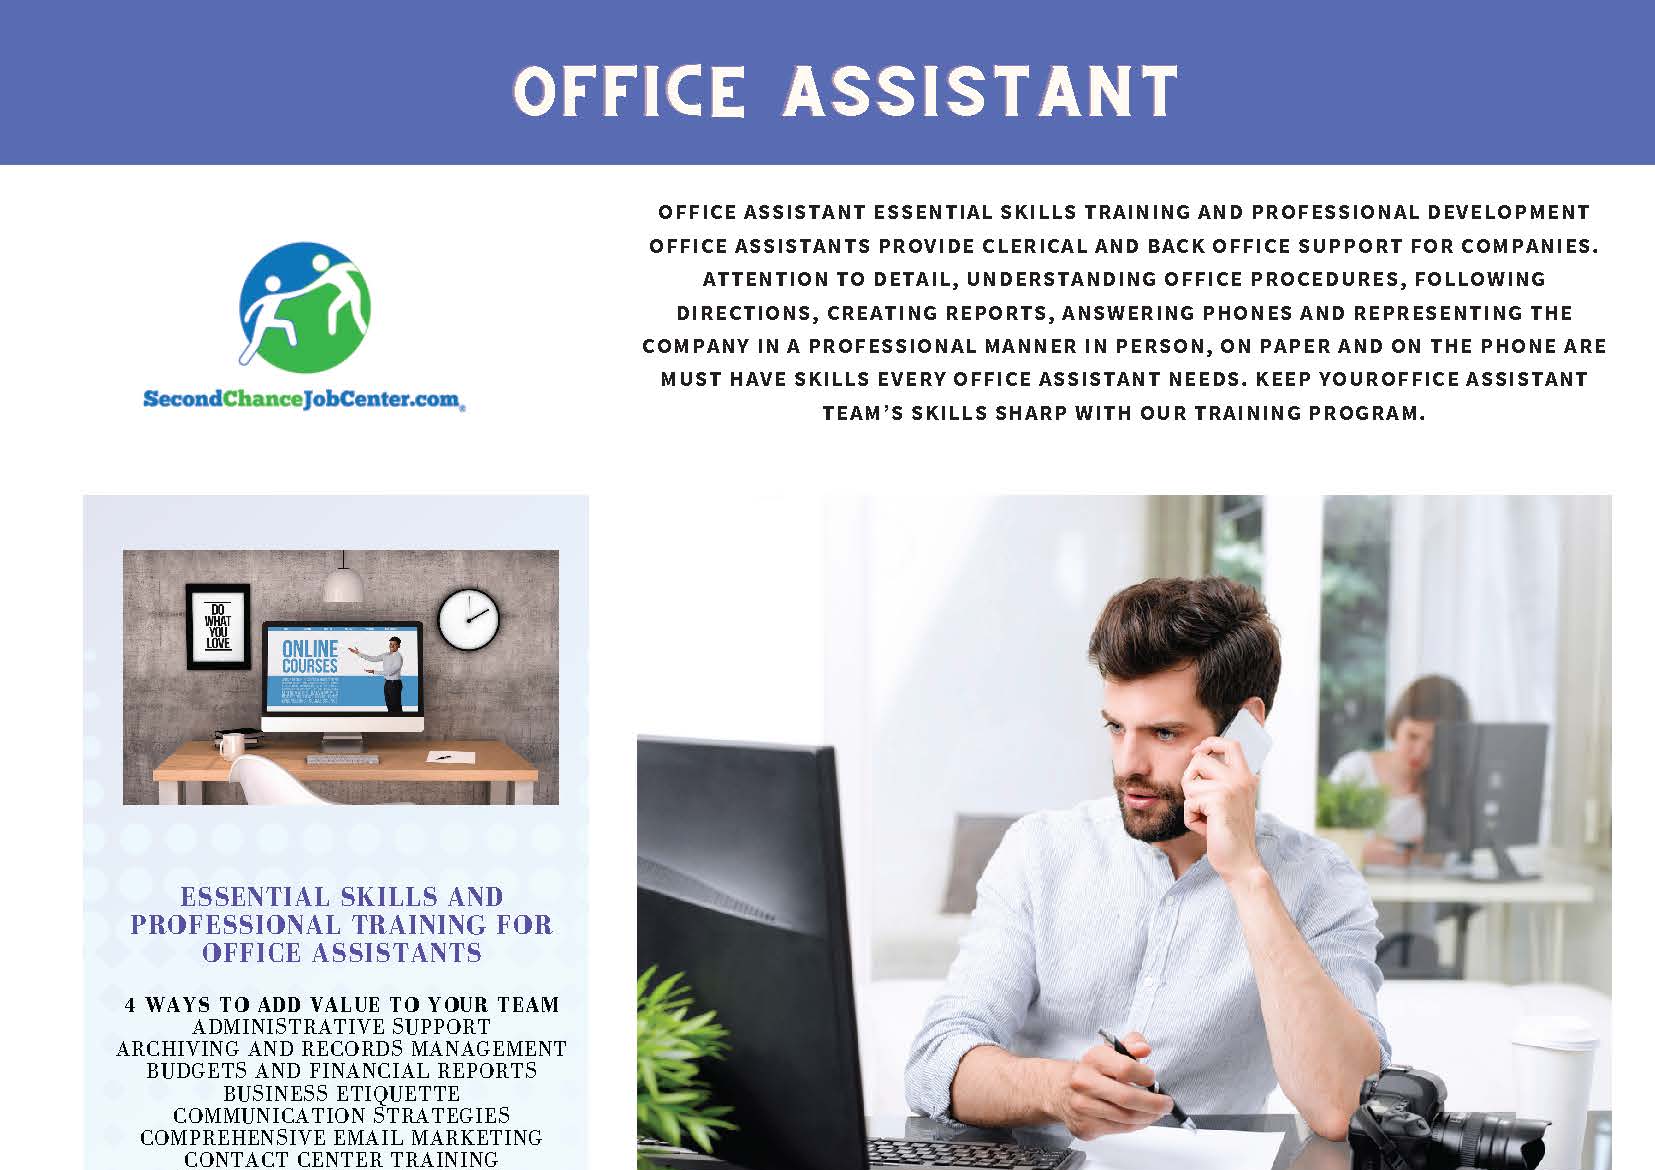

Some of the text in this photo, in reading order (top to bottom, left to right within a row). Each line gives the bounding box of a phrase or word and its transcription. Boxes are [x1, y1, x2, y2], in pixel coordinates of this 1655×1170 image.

[512, 63, 1178, 119] OFFICE ASSISTANT
[658, 204, 1590, 220] OFFICE ASSISTANT ESSENTIAL SKILLS TRAINING AND PROFESSIONAL DEVELOPMENT
[649, 238, 1598, 254] OFFICE ASSISTANTS PROVIDE CLERICAL AND BACK OFFICE SUPPORT FOR COMPANIES.
[702, 271, 1545, 291] ATTENTION TO DETAIL, UNDERSTANDING OFFICE PROCEDURES, FOLLOWING
[677, 305, 1572, 325] DIRECTIONS, CREATING REPORTS, ANSWERING PHONES AND REPRESENTING THE
[642, 338, 1606, 358] COMPANY IN A PROFESSIONAL MANNER IN PERSON, ON PAPER AND ON THE PHONE ARE
[661, 371, 1588, 387] MUST HAVE SKILLS EVERY OFFICE ASSISTANT NEEDS. KEEP YOUROFFICE ASSISTANT
[911, 405, 987, 421] SKILLS
[995, 405, 1067, 421] SHARP
[1074, 405, 1131, 421] WITH
[1140, 405, 1187, 421] OUR
[1194, 405, 1301, 421] TRAINING
[1309, 405, 1425, 421] PROGRAM.
[211, 604, 225, 615] DO
[204, 615, 231, 627] WHAT
[208, 627, 228, 637] YOU
[206, 637, 230, 649] LOVE
[282, 639, 338, 657] ONLINE
[282, 658, 338, 674] COURSES
[180, 886, 503, 907] ESSENTIAL SKILLS AND
[130, 914, 554, 936] PROFESSIONAL TRAINING FOR
[202, 942, 482, 963] OFFICE ASSISTANTS
[124, 996, 559, 1013] 4 WAYS TO ADD VALUE TO YOUR TEAM
[146, 1061, 537, 1080] BUDGETS AND FINANCIAL REPORTS
[184, 1151, 499, 1168] CONTACT CENTER TRAINING
